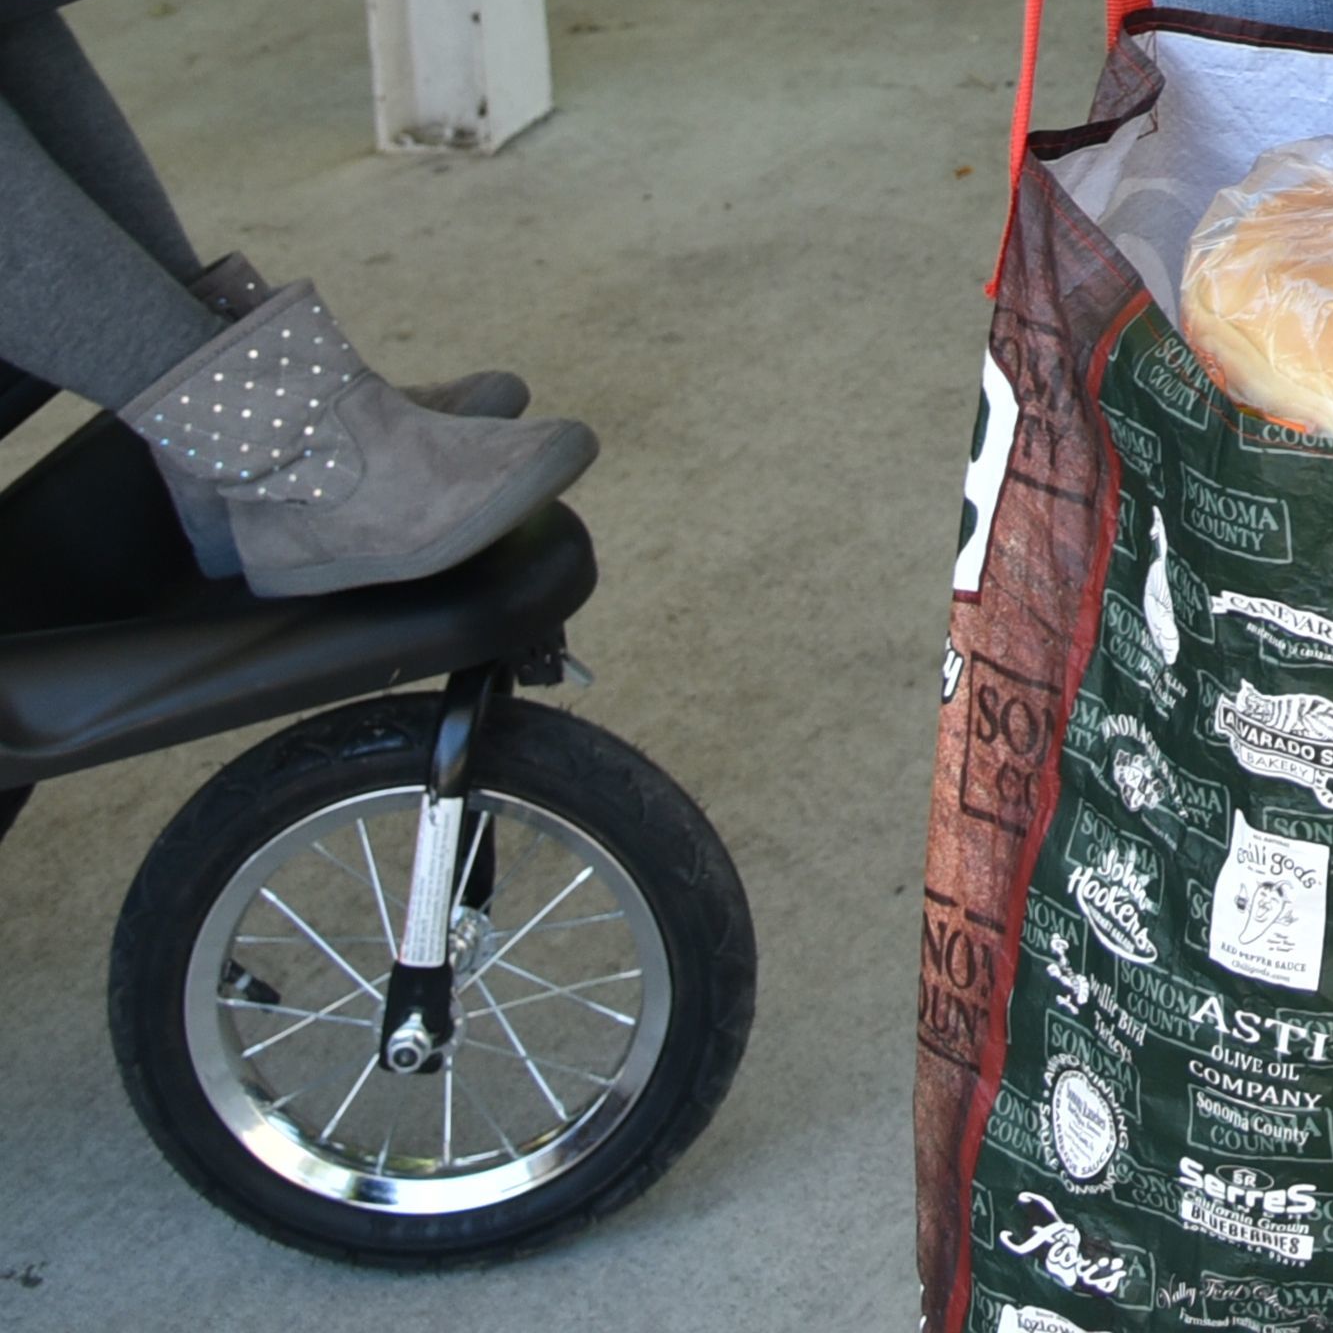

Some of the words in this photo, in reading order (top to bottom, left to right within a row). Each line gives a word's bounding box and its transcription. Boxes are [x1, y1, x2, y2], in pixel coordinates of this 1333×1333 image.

[1246, 753, 1309, 779] BAKERY
[1097, 848, 1147, 911] John
[1269, 852, 1317, 889] gods
[1274, 960, 1307, 973] SAUCE
[1117, 1010, 1148, 1046] Bird
[1127, 991, 1201, 1043] COUNTY
[1189, 995, 1331, 1062] ASTI
[1188, 1059, 1323, 1110] COMPANY
[1210, 1043, 1264, 1075] OLIVE
[1267, 1062, 1300, 1082] OIL
[1196, 1090, 1250, 1133] Sonoma
[1252, 1116, 1310, 1147] County
[1190, 1205, 1300, 1255] BLUEBERRIES
[1256, 1217, 1310, 1235] Grown
